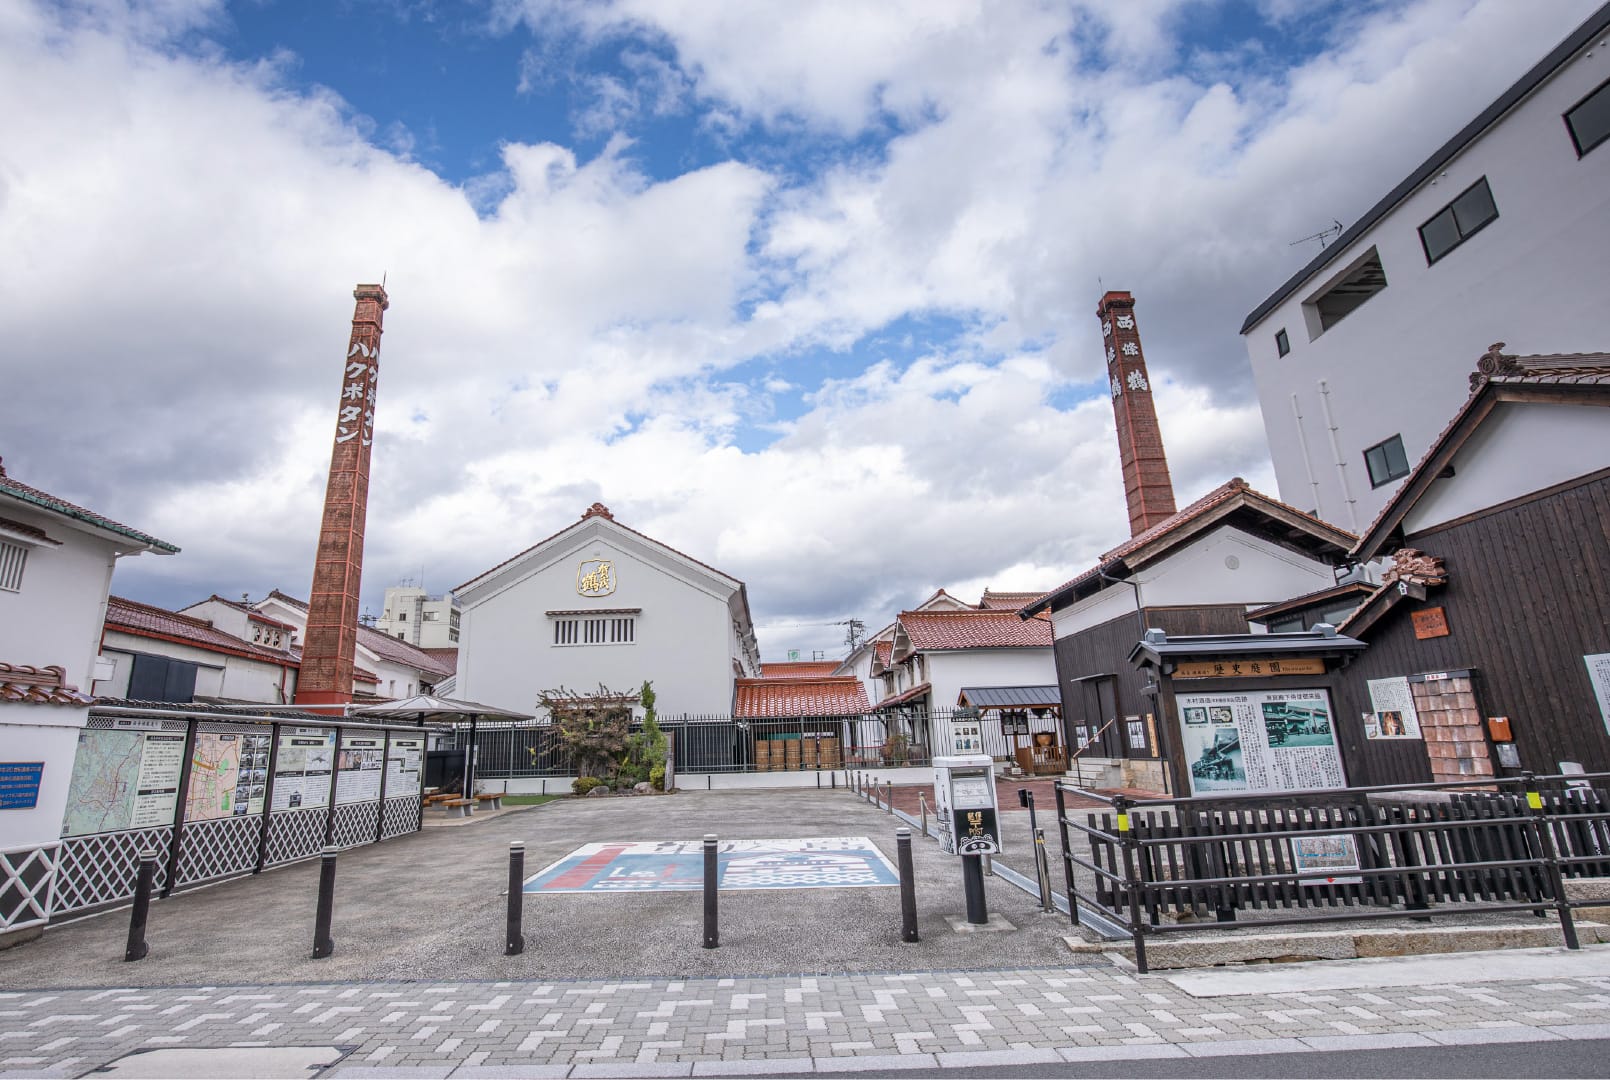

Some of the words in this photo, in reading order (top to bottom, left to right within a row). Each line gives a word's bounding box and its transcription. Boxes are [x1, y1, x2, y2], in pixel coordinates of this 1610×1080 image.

[335, 342, 370, 444] ハクボタン
[968, 827, 984, 836] POST
